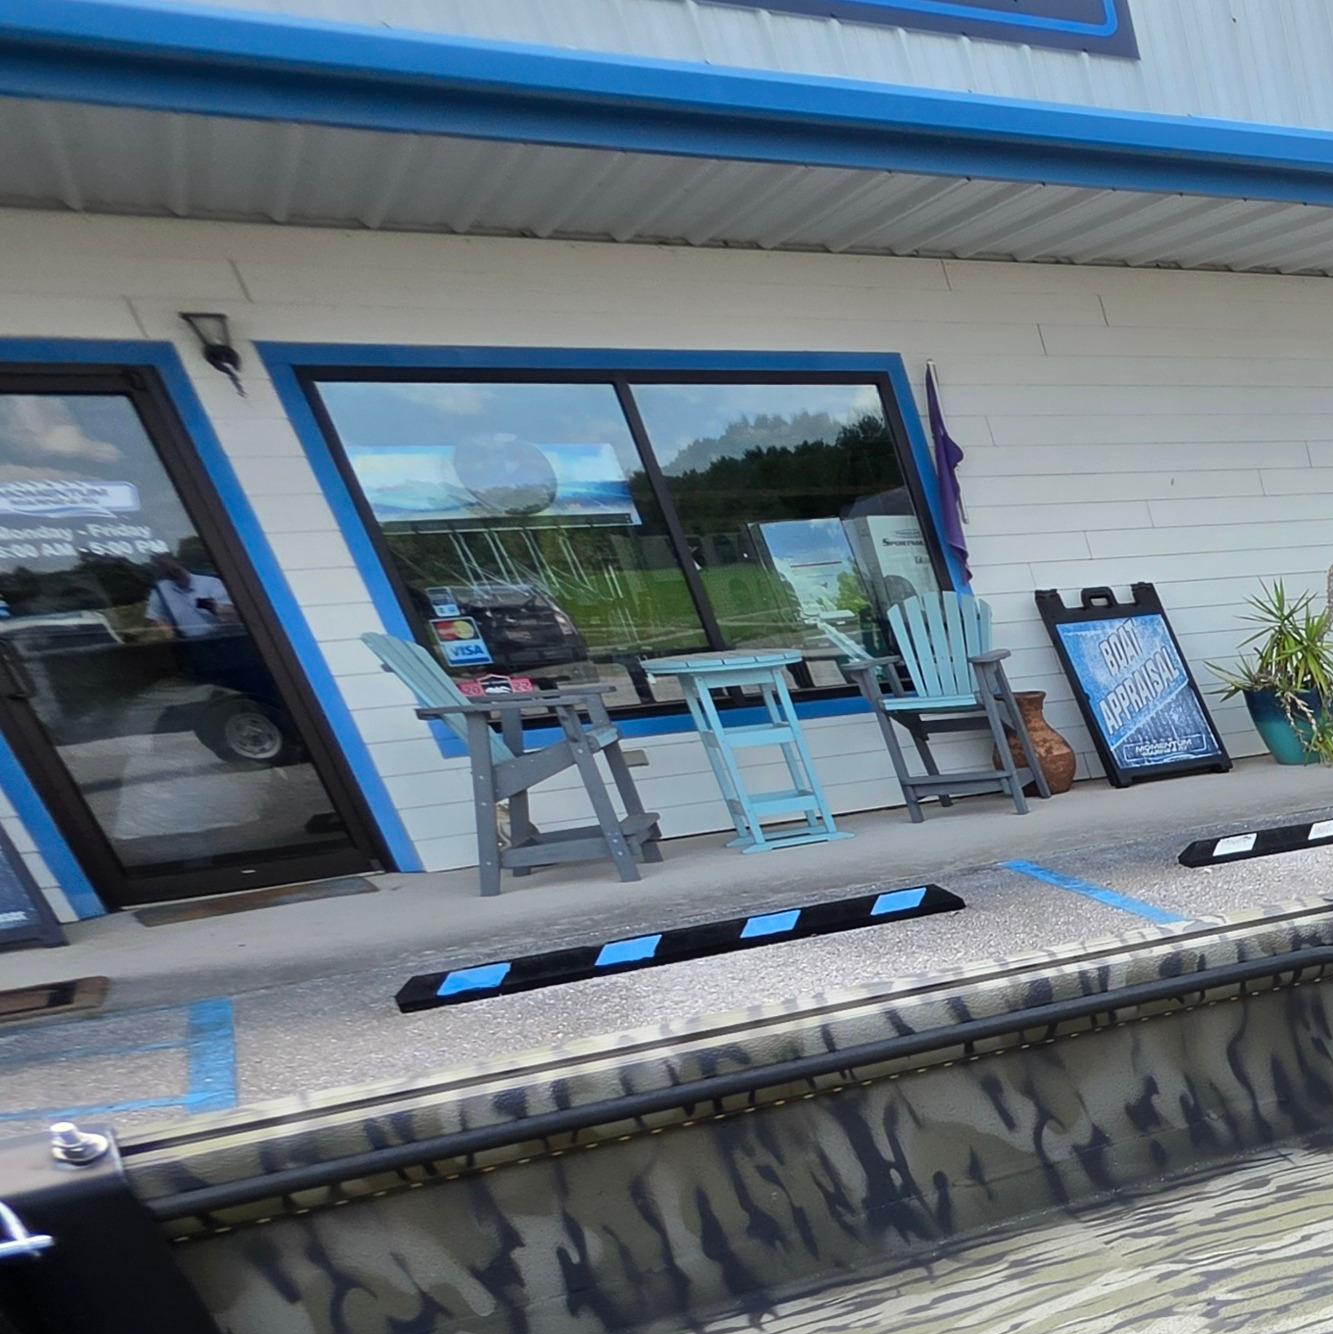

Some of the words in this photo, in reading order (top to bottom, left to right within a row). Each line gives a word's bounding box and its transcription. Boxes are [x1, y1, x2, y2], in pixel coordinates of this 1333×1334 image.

[86, 523, 151, 539] Friday
[134, 539, 170, 553] PM
[450, 644, 484, 657] VISA
[1099, 617, 1143, 676] BOAT
[1099, 645, 1180, 736] APPRAISAL
